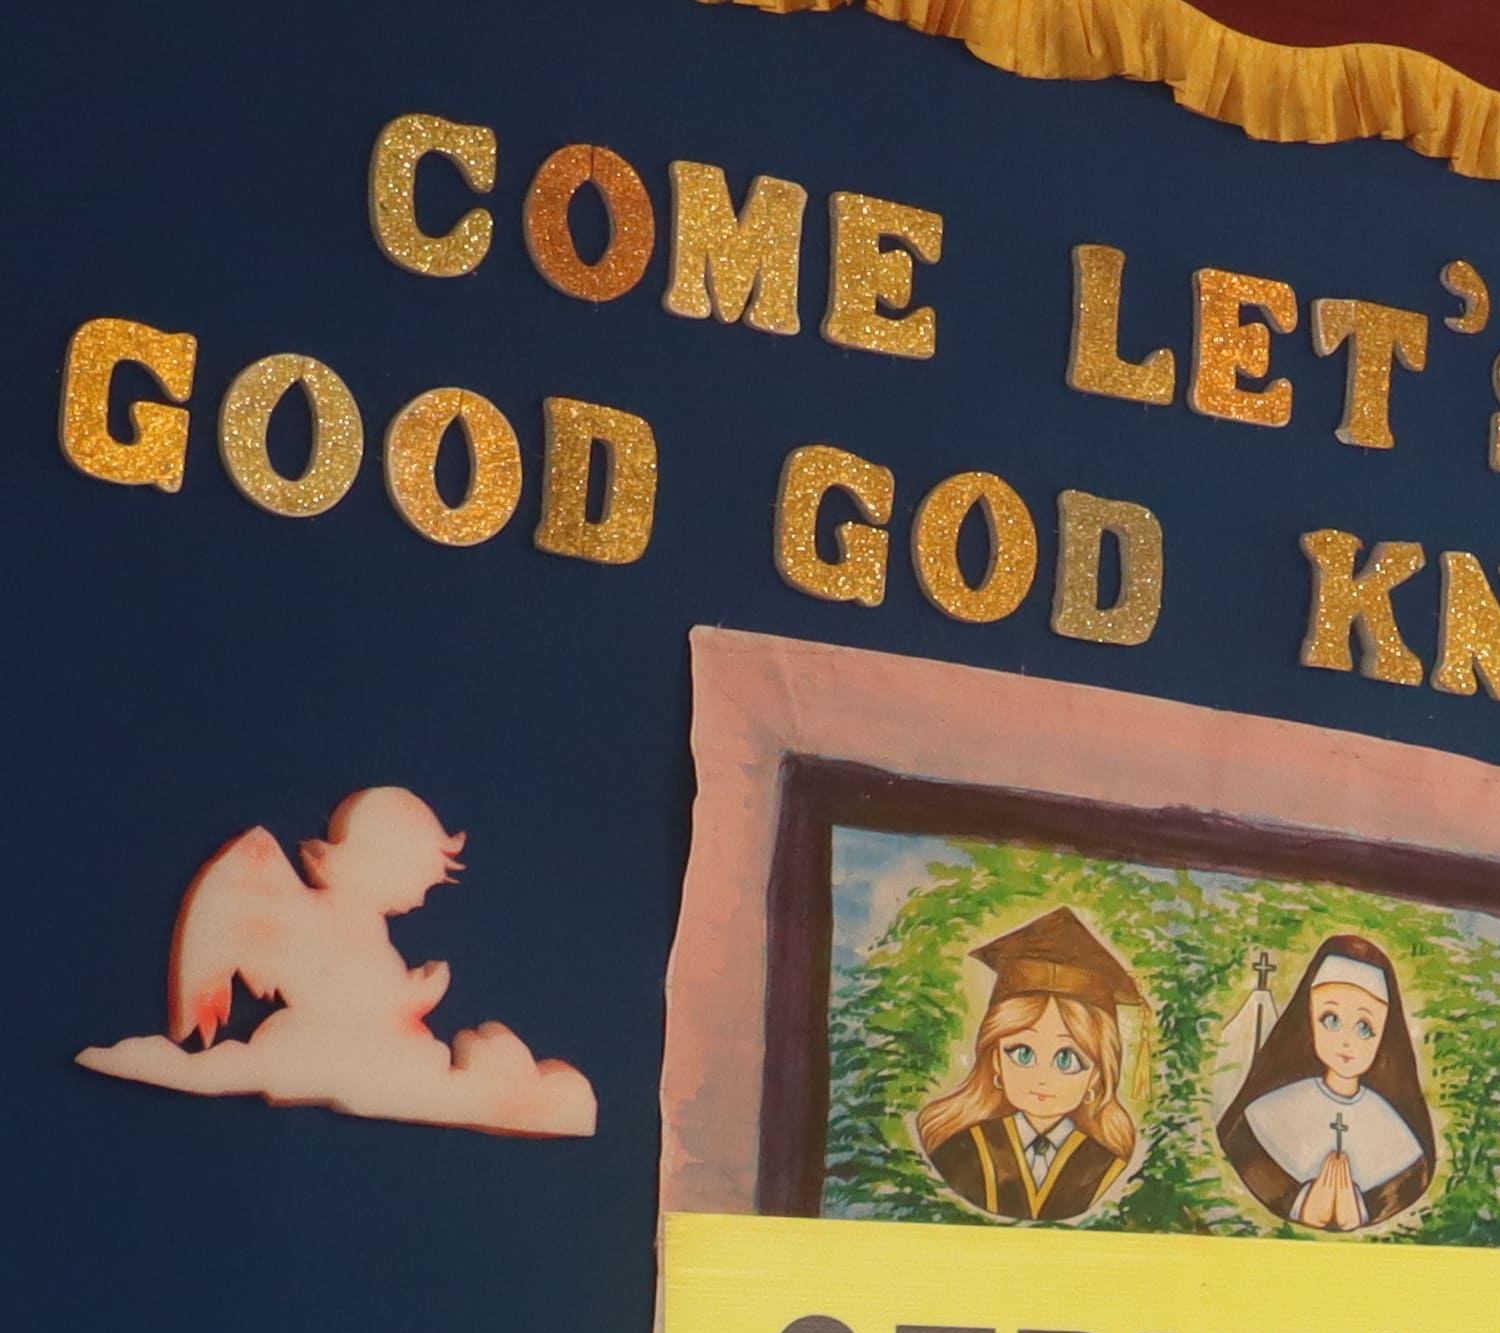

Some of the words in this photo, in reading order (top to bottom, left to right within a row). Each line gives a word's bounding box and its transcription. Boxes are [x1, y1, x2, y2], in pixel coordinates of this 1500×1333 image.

[368, 111, 945, 361] COME
[57, 316, 659, 566] GOOD
[773, 443, 1166, 647] GOD
